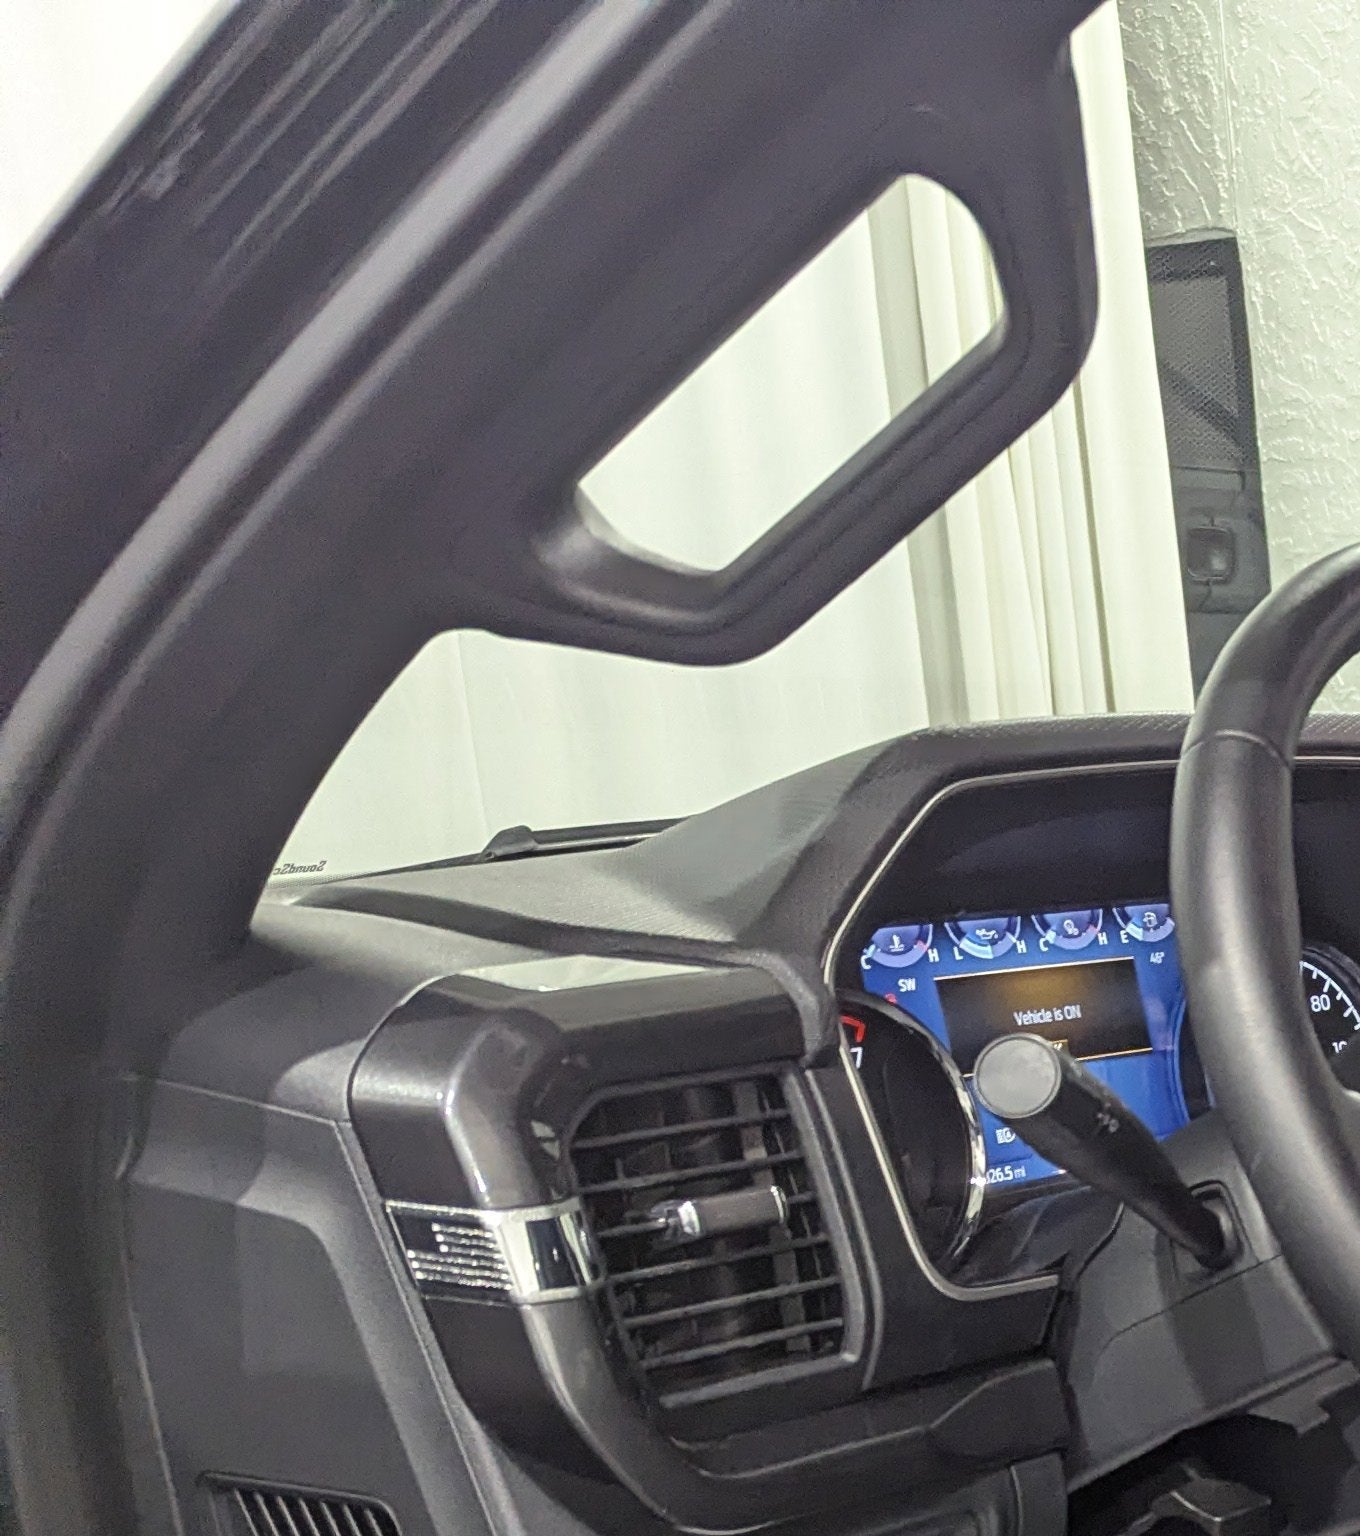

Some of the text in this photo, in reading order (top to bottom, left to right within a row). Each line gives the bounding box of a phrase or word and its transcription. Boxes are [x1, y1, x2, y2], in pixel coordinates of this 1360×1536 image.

[1098, 932, 1109, 946] H
[1121, 930, 1130, 944] E
[1016, 939, 1027, 954] H
[928, 949, 940, 963] H
[953, 948, 964, 961] L
[897, 977, 917, 993] SW
[1310, 994, 1332, 1013] 80
[1013, 1004, 1082, 1027] Vehicle is ON
